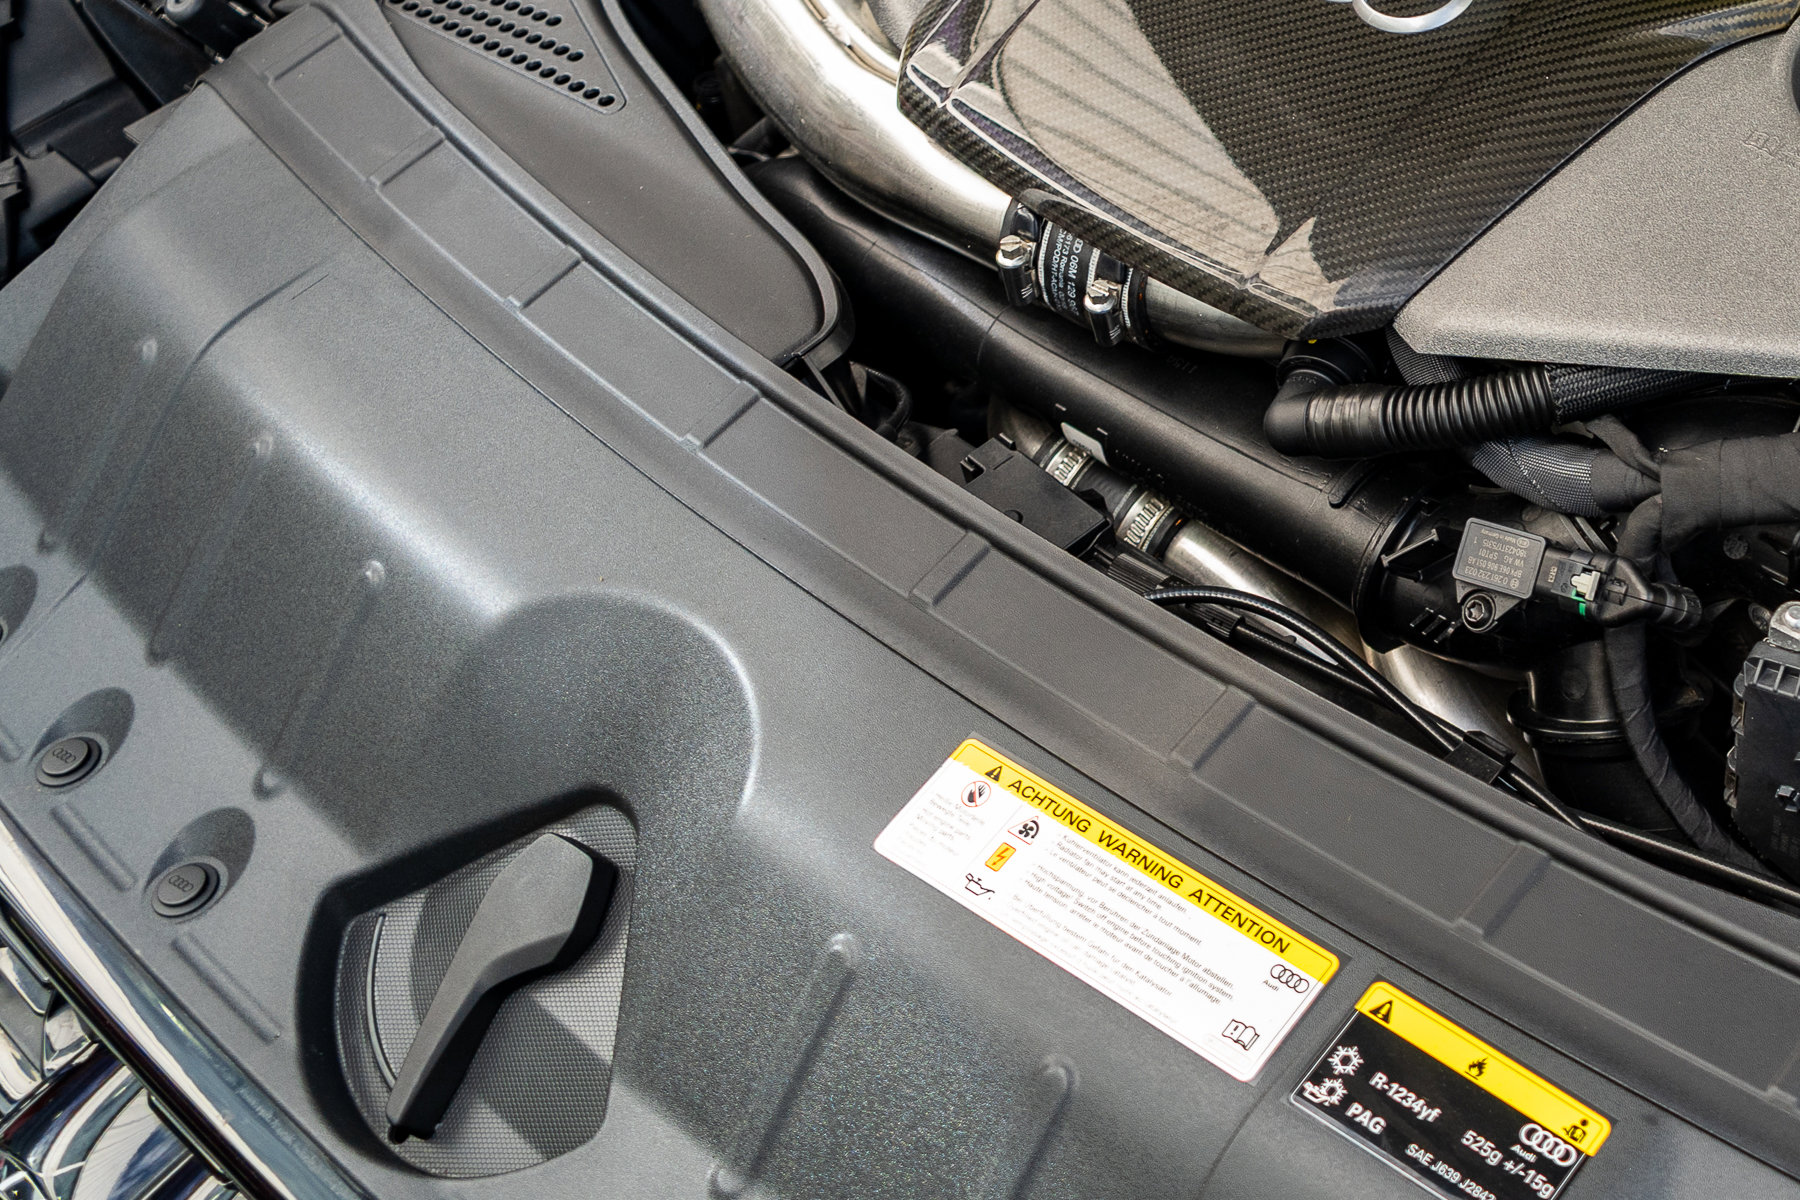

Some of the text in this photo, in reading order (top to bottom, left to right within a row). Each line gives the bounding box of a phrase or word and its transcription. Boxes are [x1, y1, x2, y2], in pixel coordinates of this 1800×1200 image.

[1067, 254, 1079, 278] 06M
[1502, 554, 1513, 564] AG
[1513, 558, 1524, 567] VW
[1005, 776, 1291, 955] ACHTUNG WARNING ATTENTION
[1054, 841, 1084, 861] Radiator
[1082, 858, 1095, 868] fan
[1109, 874, 1126, 887] start
[1072, 897, 1097, 915] Switch
[1095, 911, 1107, 922] off
[1104, 918, 1130, 937] engine
[1128, 932, 1152, 950] before
[1149, 946, 1182, 969] touching
[1180, 964, 1209, 986] ignition
[1098, 925, 1124, 944] moteur
[1123, 941, 1144, 956] avant
[1142, 952, 1154, 962] de
[1152, 958, 1180, 978] toucher
[1179, 952, 1203, 969] Motor
[1261, 978, 1280, 992] Audi
[1344, 1100, 1388, 1136] PAG
[1403, 1141, 1434, 1167] SAE
[1429, 1158, 1462, 1185] J639
[1366, 1070, 1558, 1200] R-1234yf 525g +/-15g
[1509, 1142, 1538, 1164] Audi
